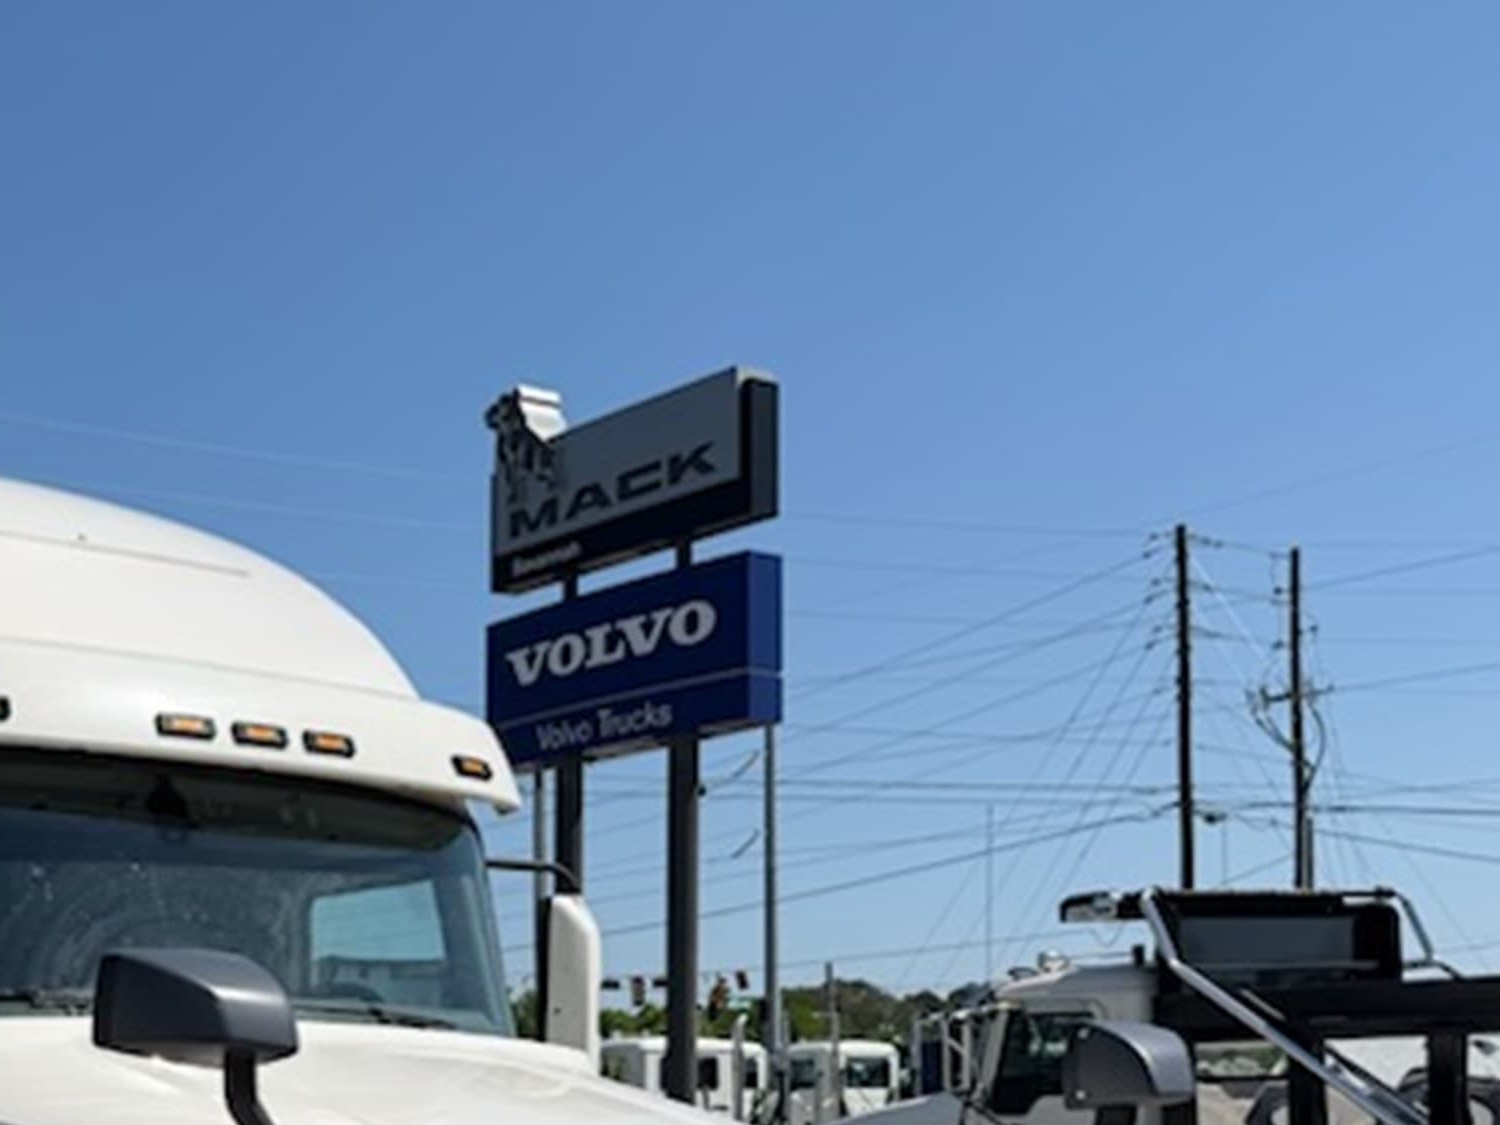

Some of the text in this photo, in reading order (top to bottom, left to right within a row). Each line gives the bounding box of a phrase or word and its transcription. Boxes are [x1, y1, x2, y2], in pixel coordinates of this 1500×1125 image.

[509, 441, 717, 539] MACK
[505, 600, 717, 686] VOLVO
[534, 702, 673, 750] Volvo Trucks
